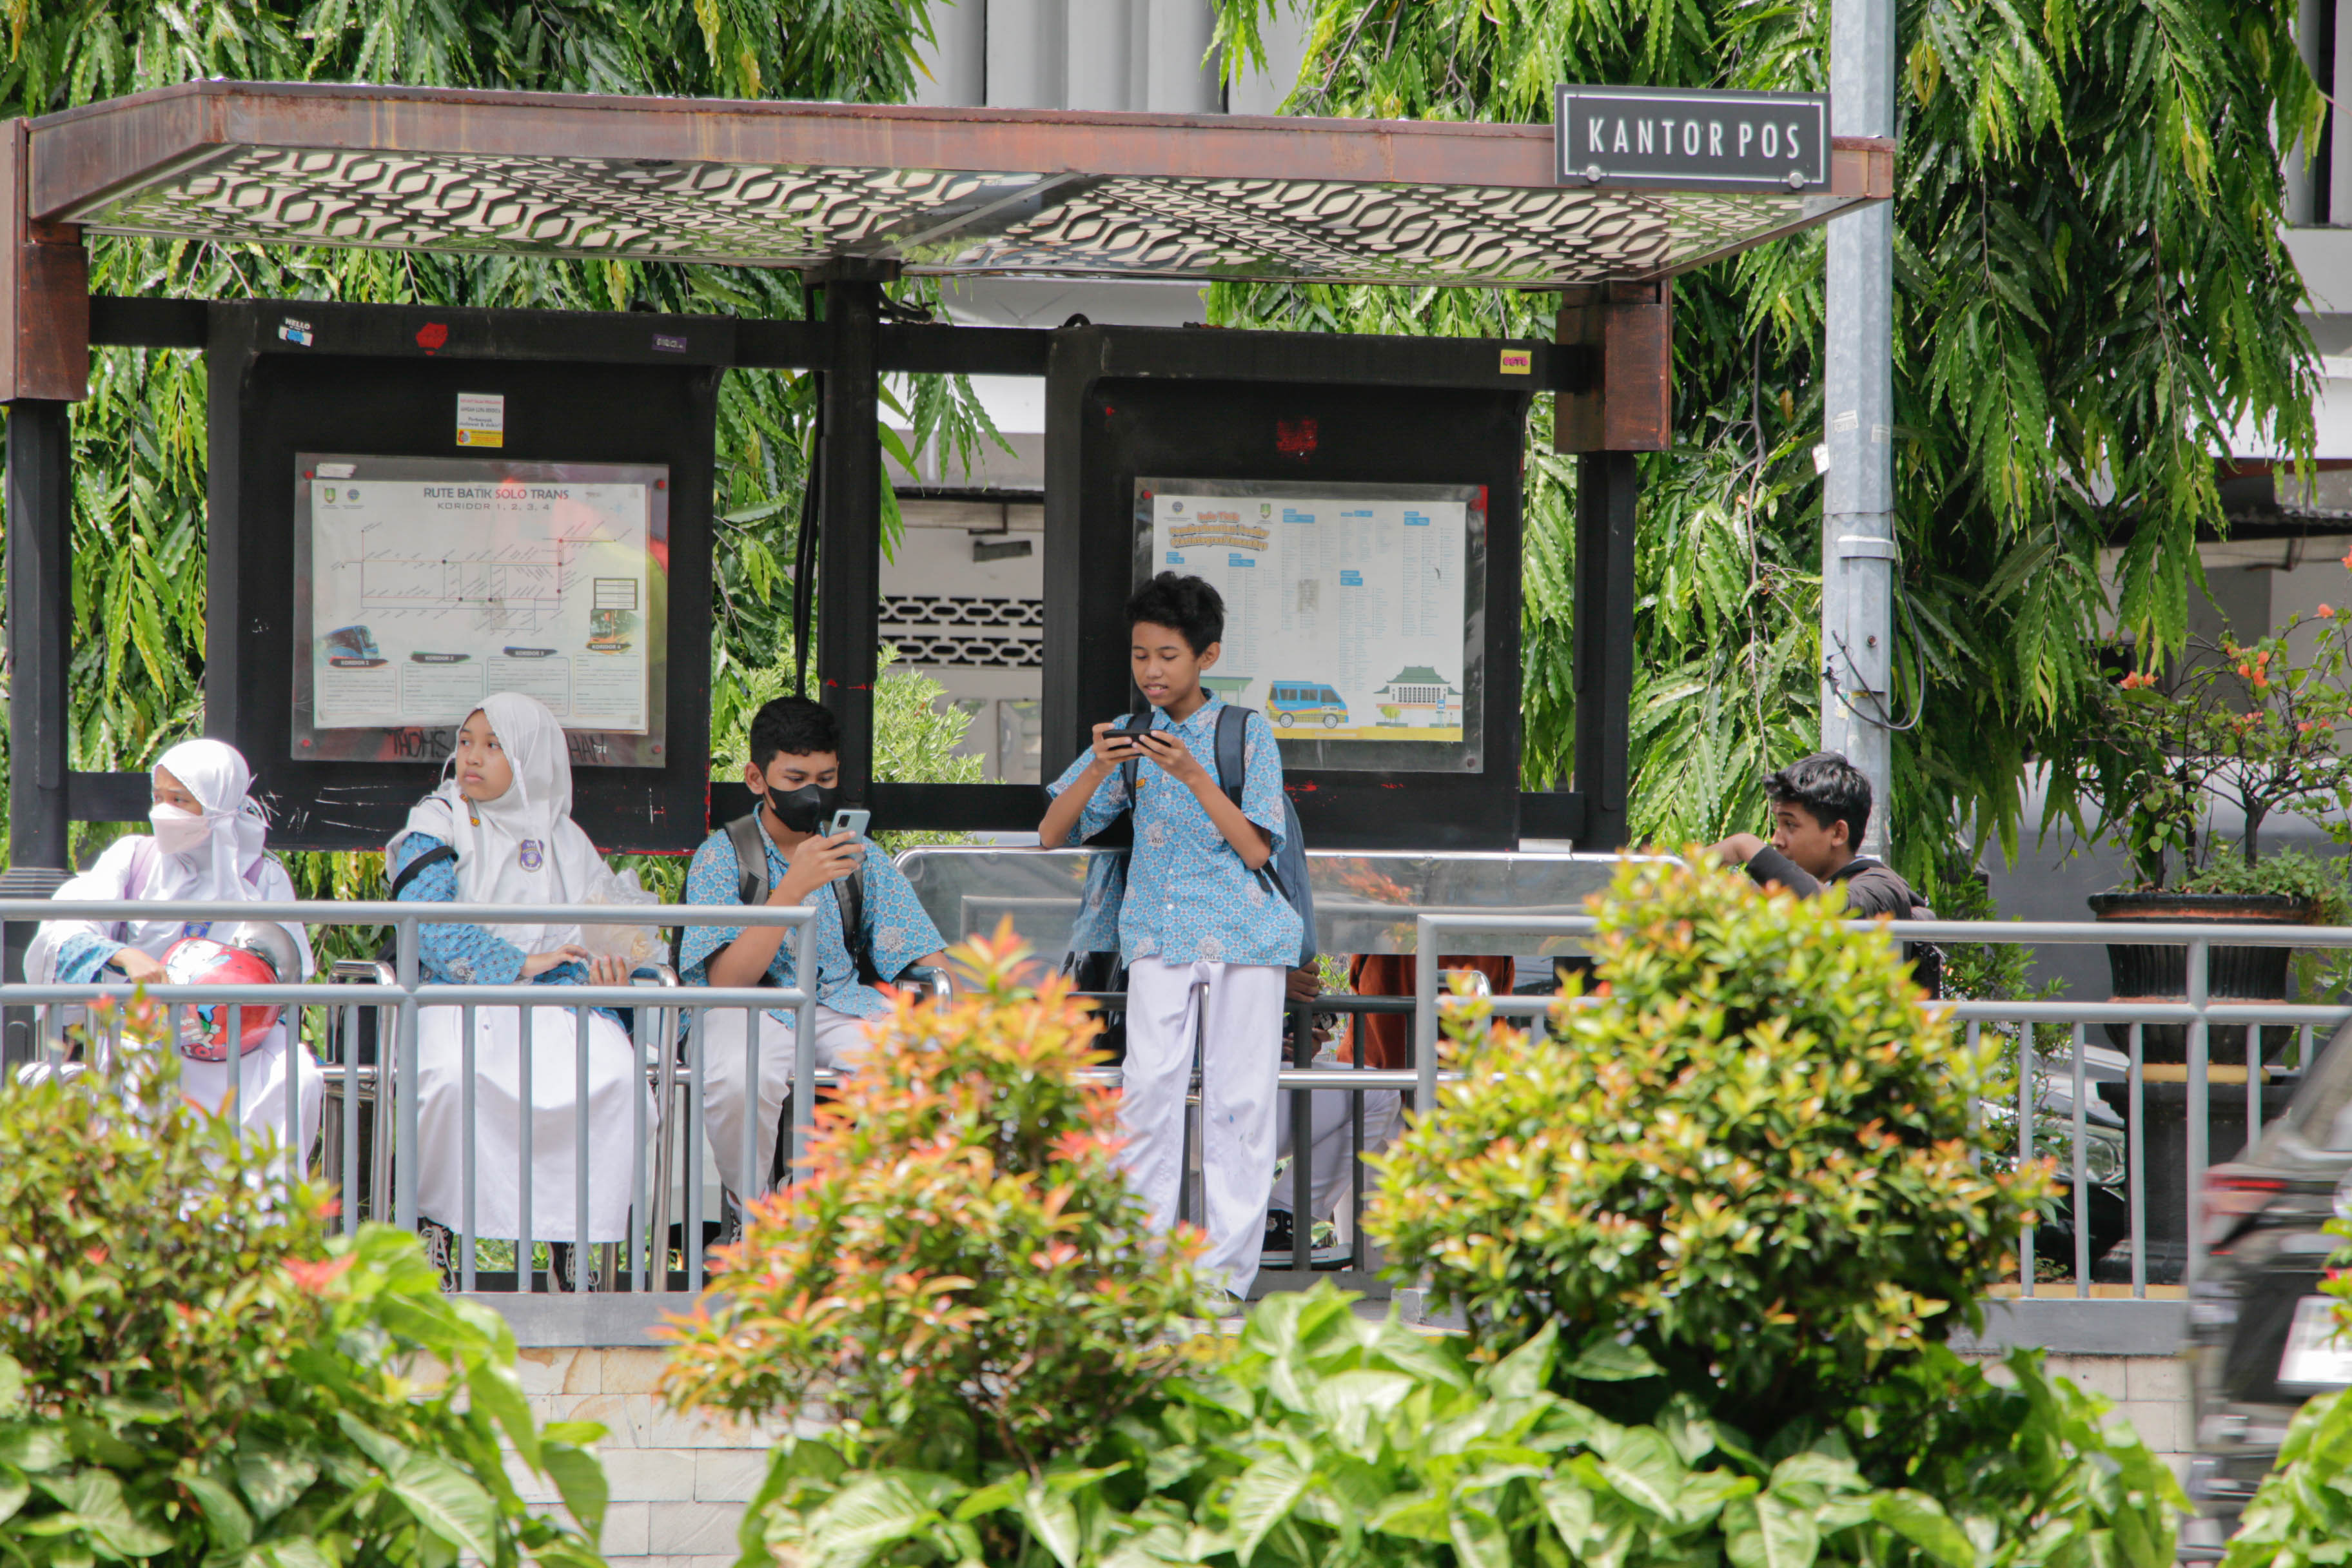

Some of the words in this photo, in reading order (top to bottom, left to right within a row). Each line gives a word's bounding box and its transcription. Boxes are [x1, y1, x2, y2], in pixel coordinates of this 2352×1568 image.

[1589, 117, 1723, 157] KANTOR
[1738, 122, 1799, 159] POS
[284, 317, 311, 329] HELLO
[424, 487, 454, 498] RUTE
[457, 488, 492, 499] BATIK
[495, 489, 527, 499] SOLO
[531, 489, 569, 500] TRANS
